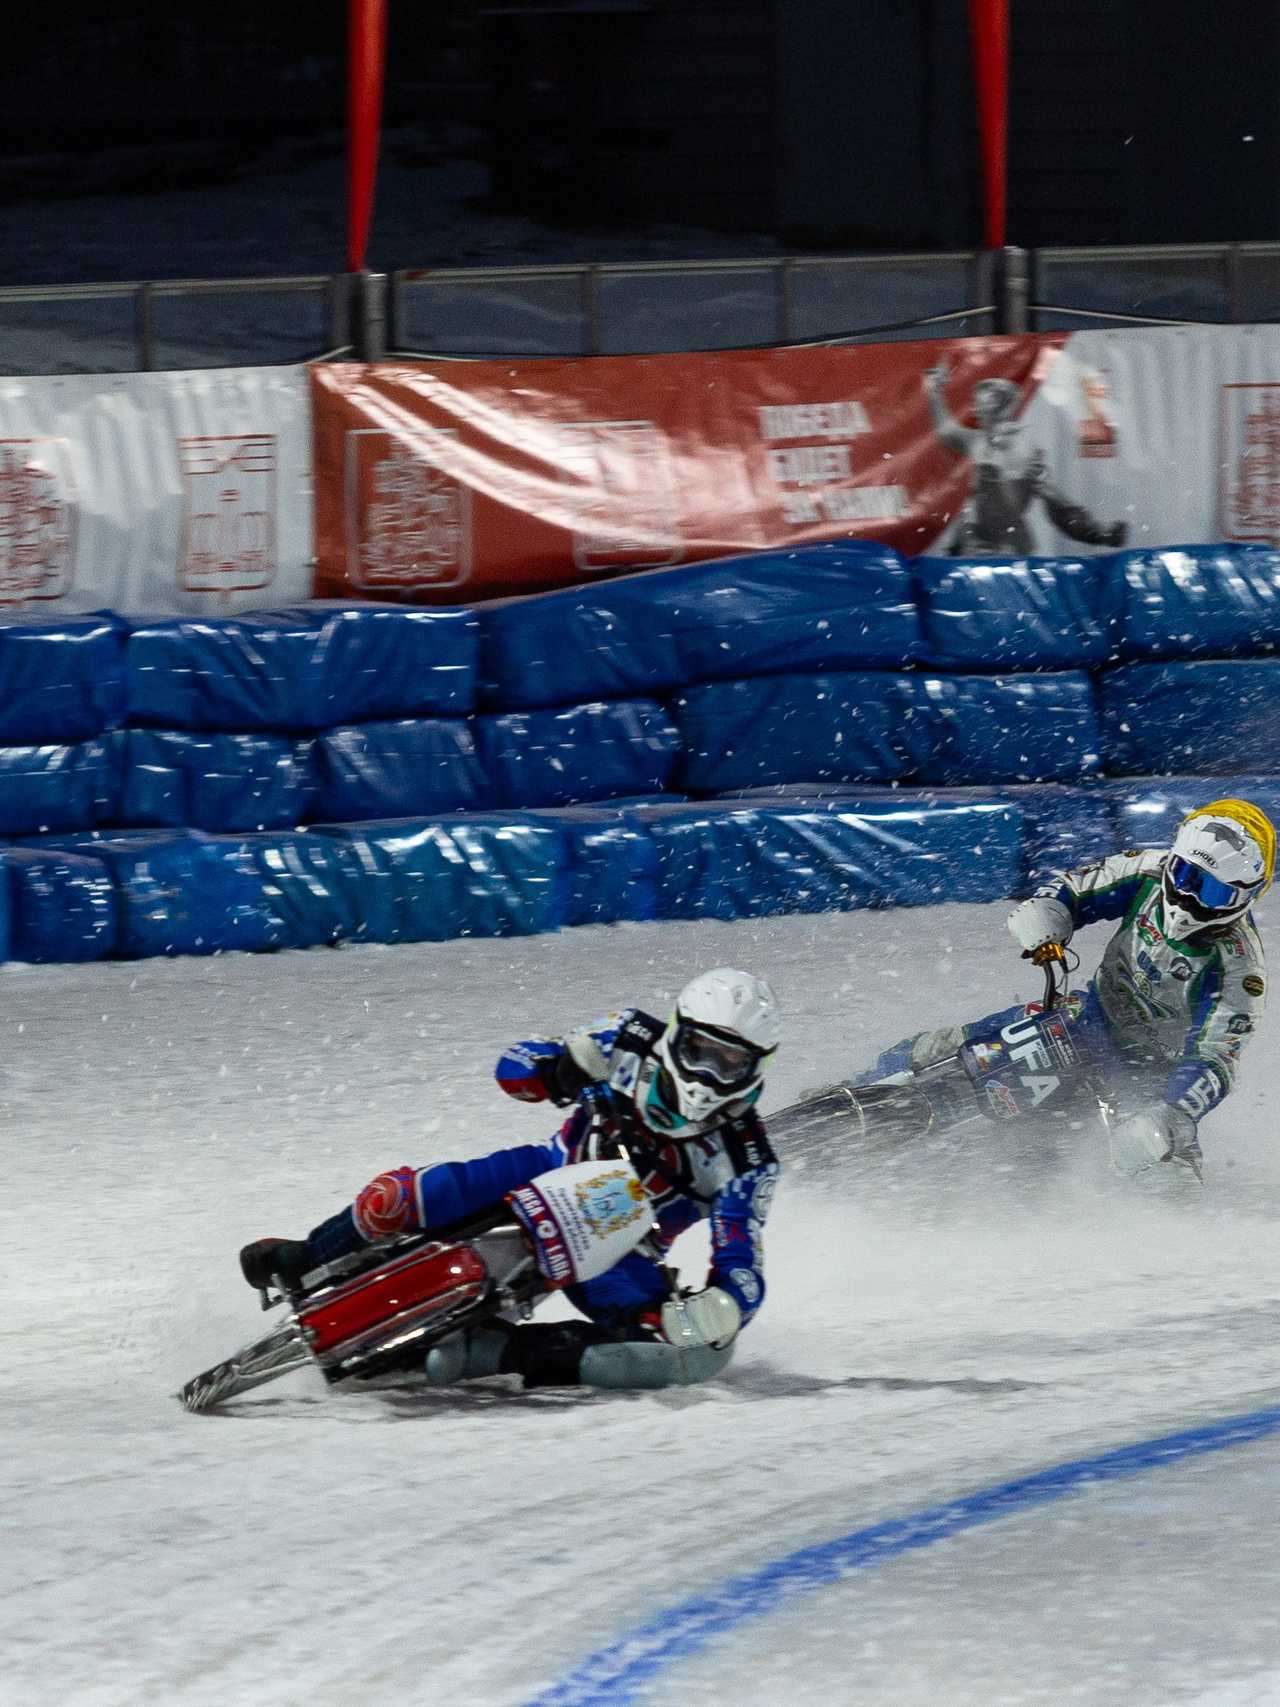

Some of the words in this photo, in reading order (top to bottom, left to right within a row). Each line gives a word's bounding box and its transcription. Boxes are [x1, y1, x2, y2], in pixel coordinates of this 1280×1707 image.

[1191, 849, 1216, 866] SHOEI
[1000, 1016, 1061, 1108] UFA
[1178, 1069, 1221, 1117] UFA
[514, 1186, 546, 1218] MEGA
[544, 1244, 572, 1281] LADA
